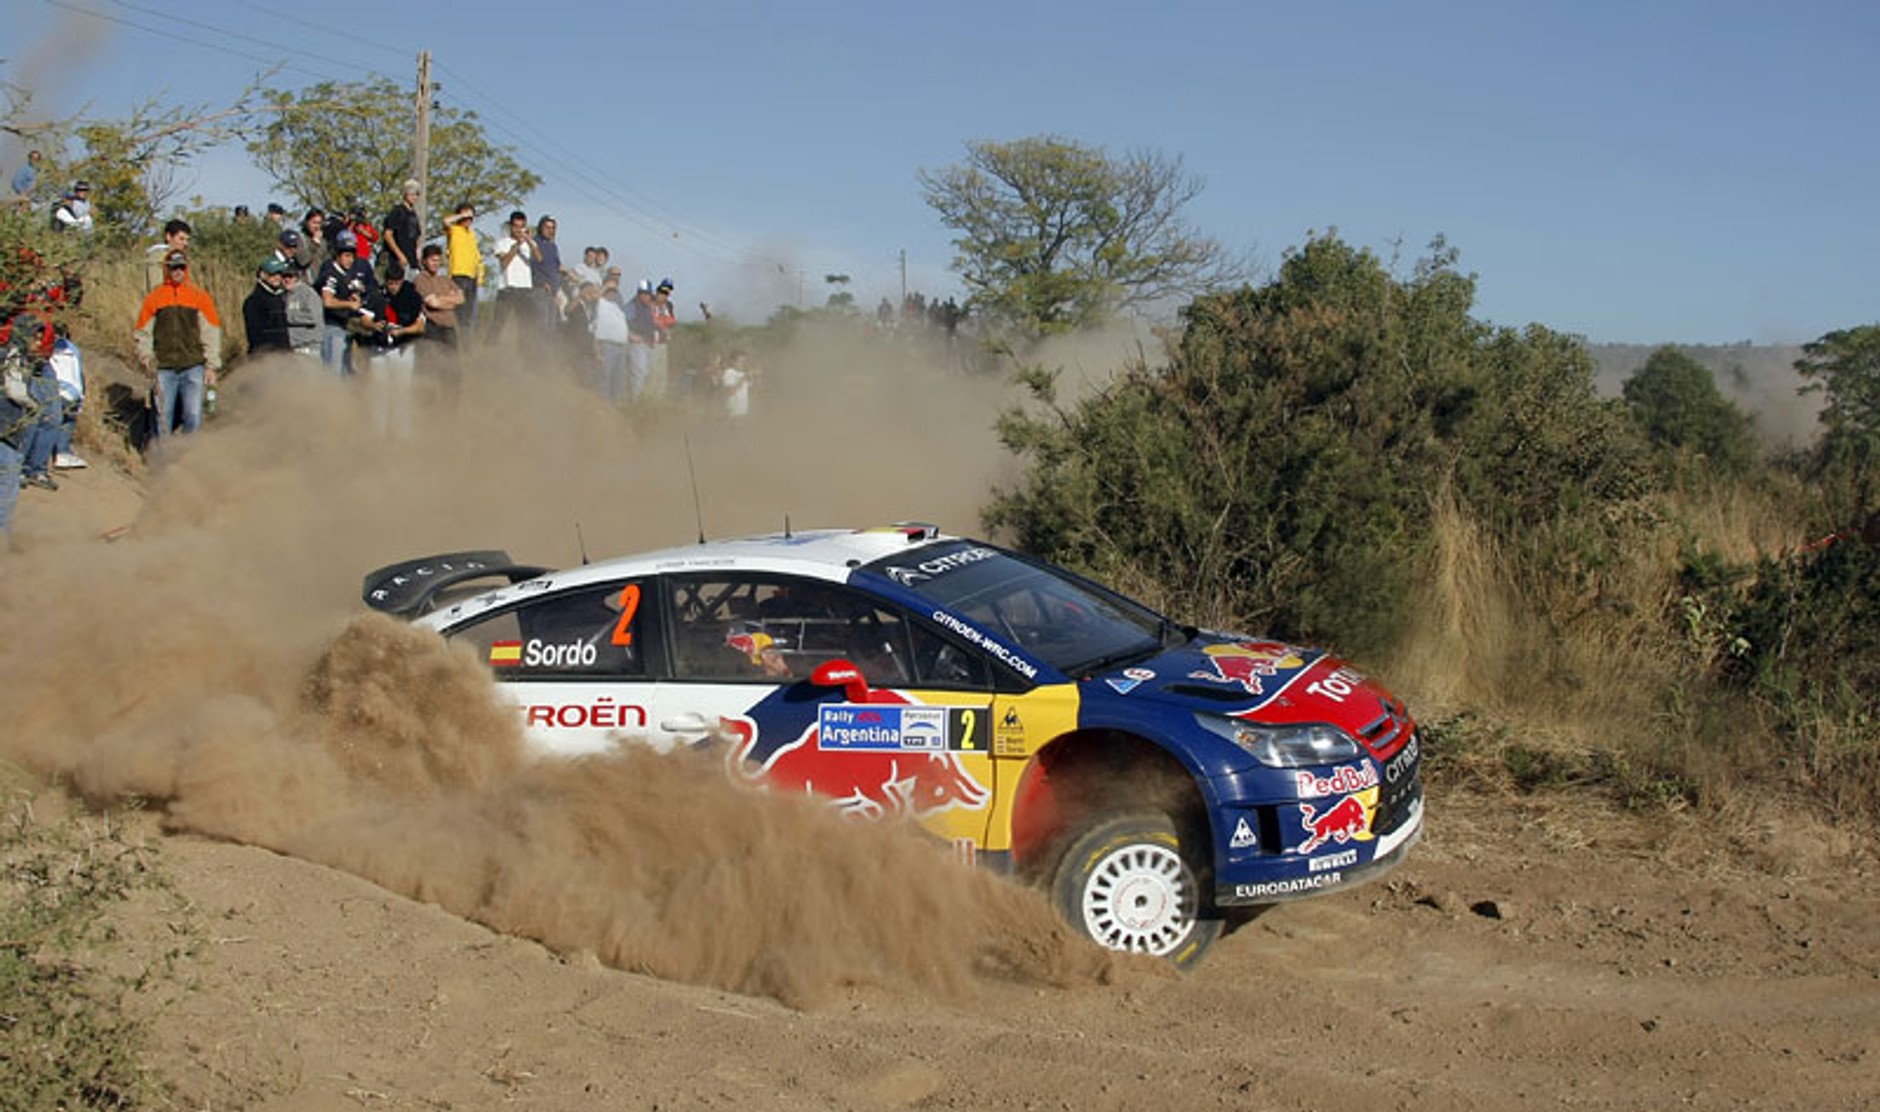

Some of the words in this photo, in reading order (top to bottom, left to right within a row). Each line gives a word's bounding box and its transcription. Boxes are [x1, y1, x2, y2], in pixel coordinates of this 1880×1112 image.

[611, 584, 641, 646] 2
[525, 638, 597, 667] Sordo
[932, 611, 1038, 679] CITROEN-WRC.COM
[824, 710, 854, 724] Rally
[961, 709, 975, 750] 2
[822, 725, 900, 745] Argentina
[1235, 872, 1341, 897] EURODATACAR
